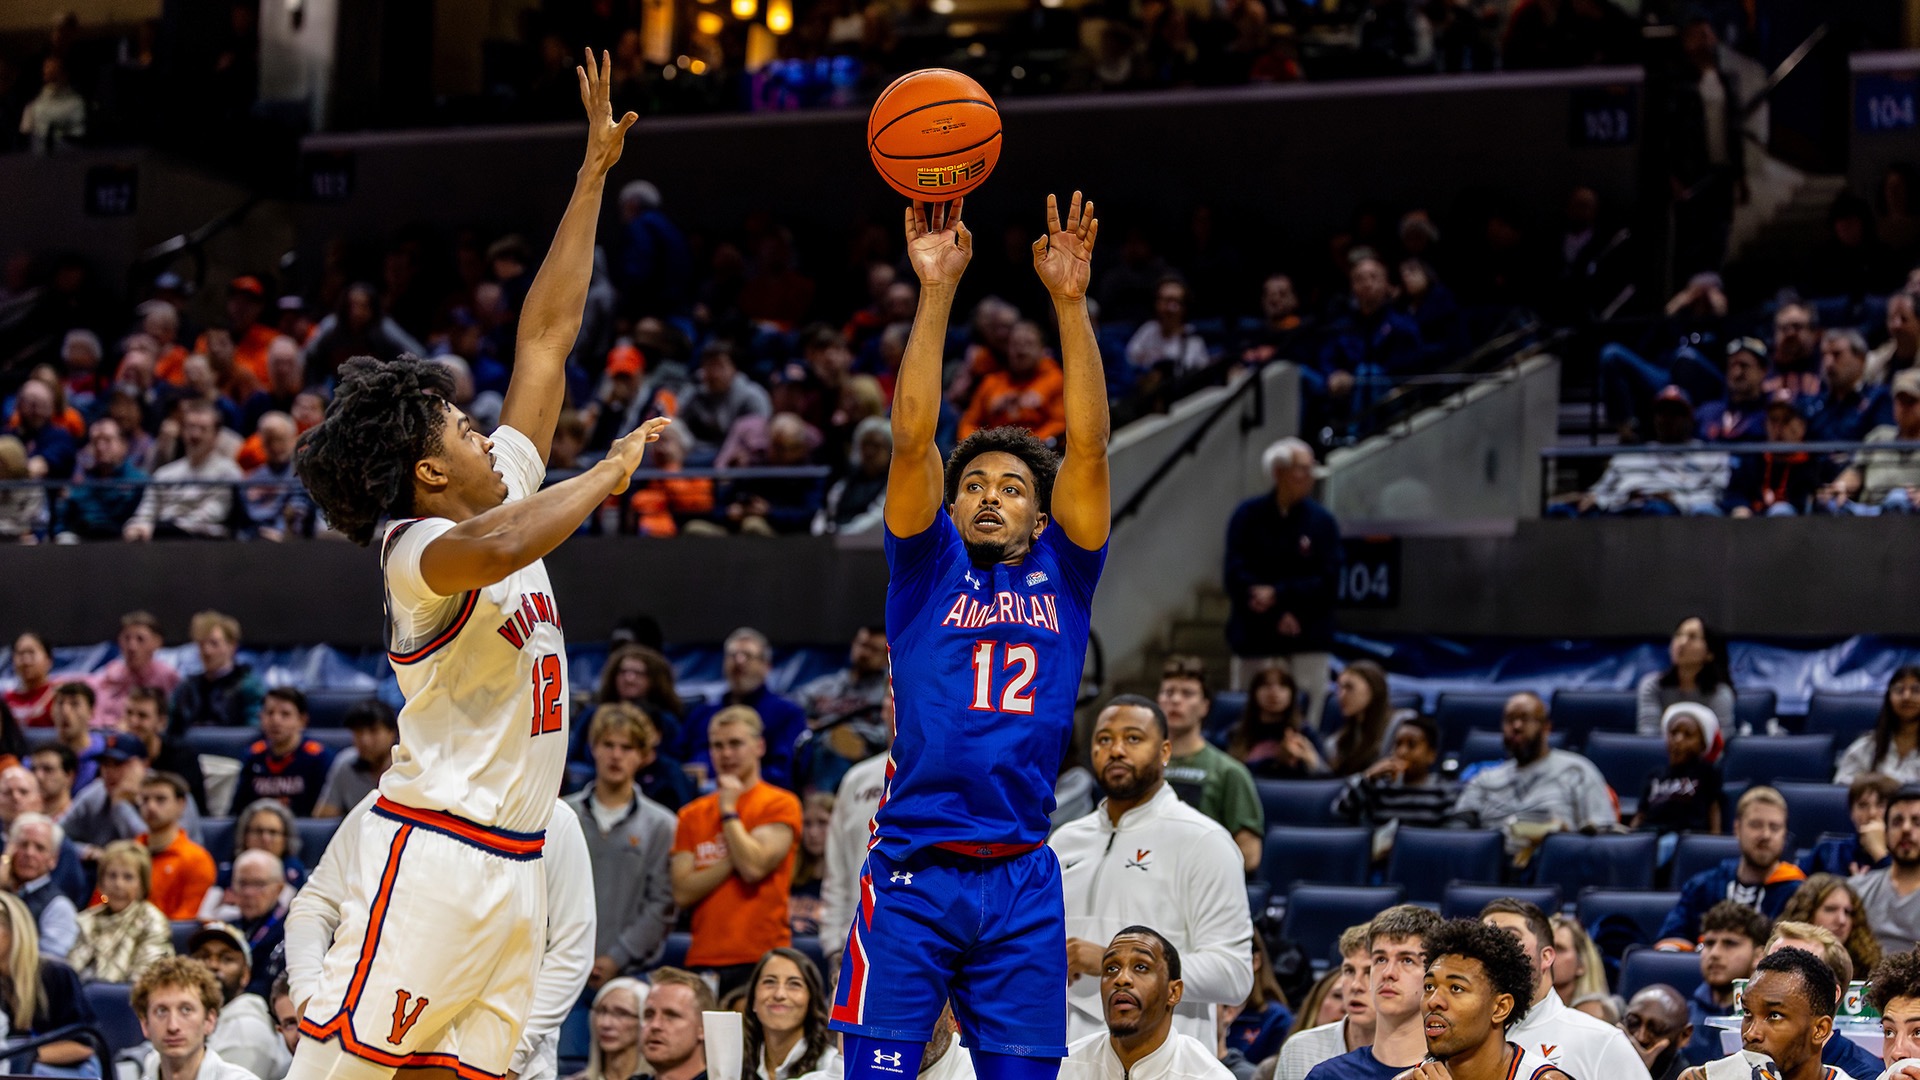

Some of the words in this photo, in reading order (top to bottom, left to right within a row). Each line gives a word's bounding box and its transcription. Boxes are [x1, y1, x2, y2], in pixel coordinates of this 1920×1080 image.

[917, 152, 985, 172] MPIONSHIP
[917, 157, 986, 187] ELITE
[1337, 563, 1389, 600] 104
[940, 590, 1060, 634] AMERICAN
[530, 653, 562, 737] 12
[968, 639, 1038, 716] 12
[387, 988, 429, 1045] V
